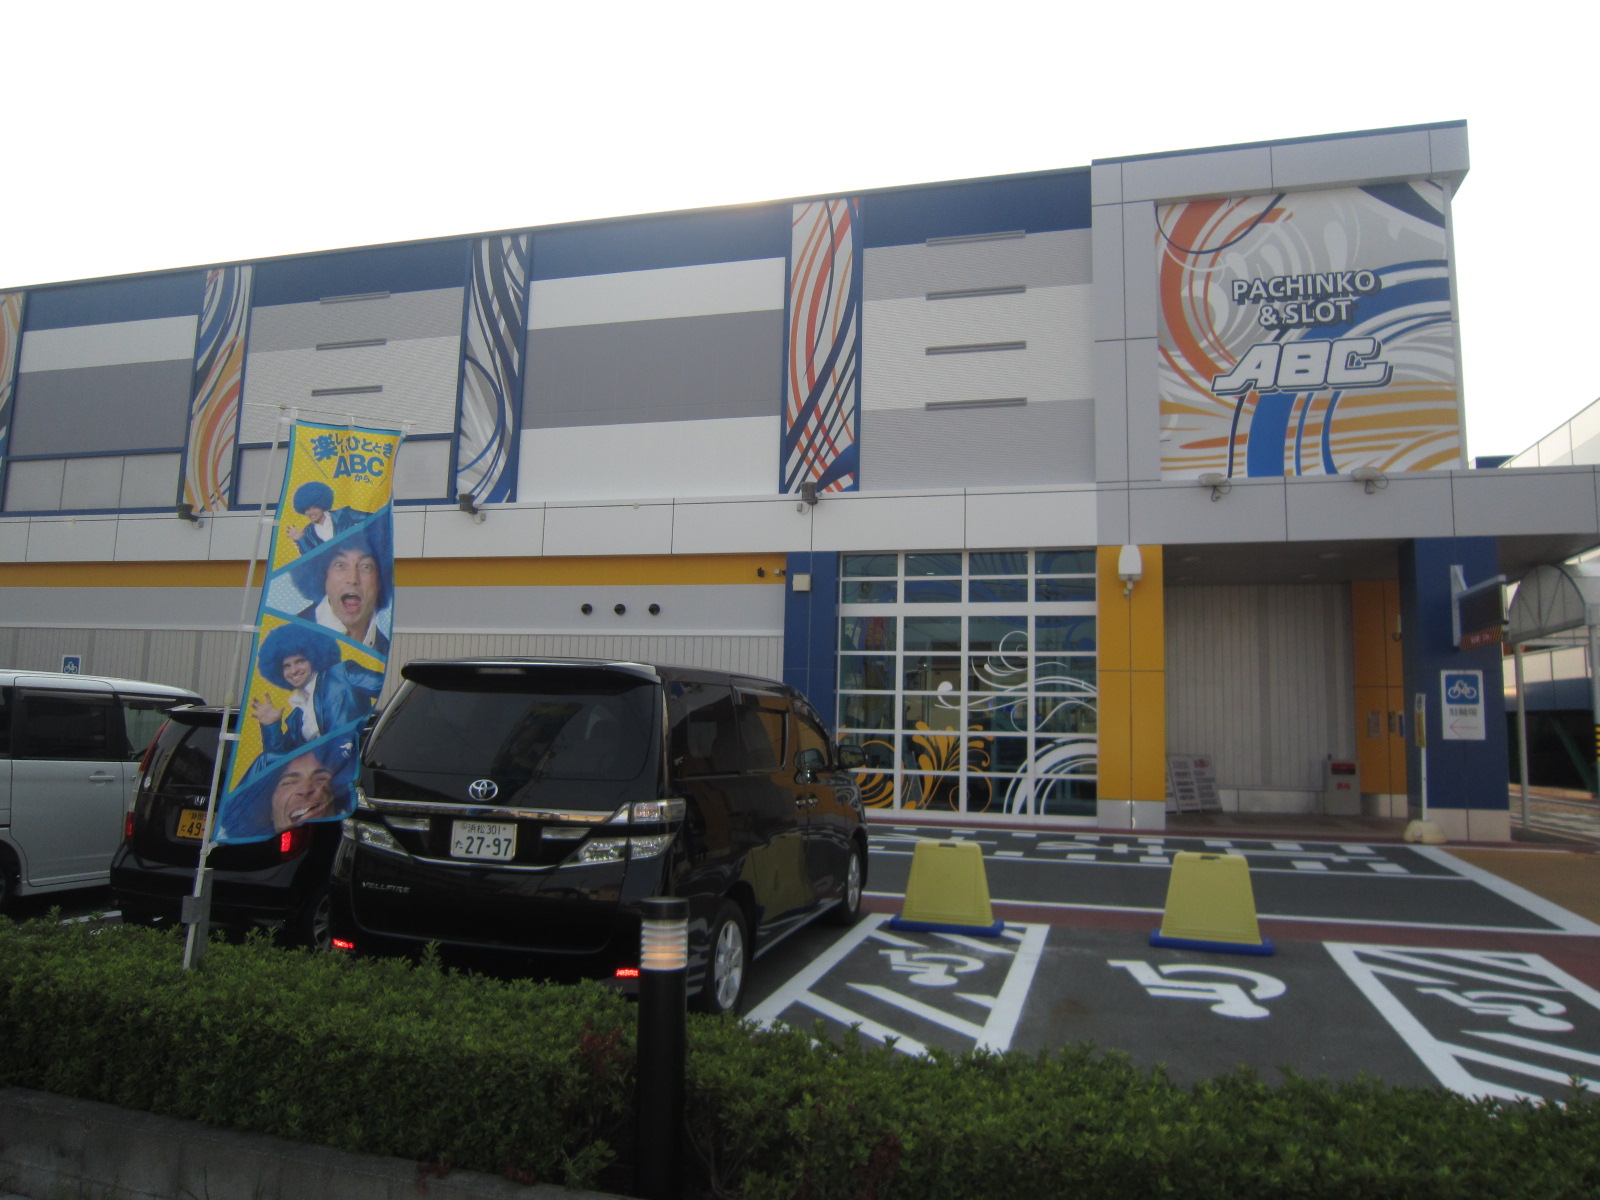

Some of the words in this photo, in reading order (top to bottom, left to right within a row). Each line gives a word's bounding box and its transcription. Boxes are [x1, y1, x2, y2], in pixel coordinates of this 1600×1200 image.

[1233, 270, 1380, 302] PACHINKO
[1259, 303, 1279, 327] &
[1286, 299, 1354, 325] SLOT
[1211, 337, 1392, 396] ABC
[310, 433, 394, 462] 楽しいひととき
[333, 454, 385, 479] ABC
[465, 835, 512, 857] 27-97
